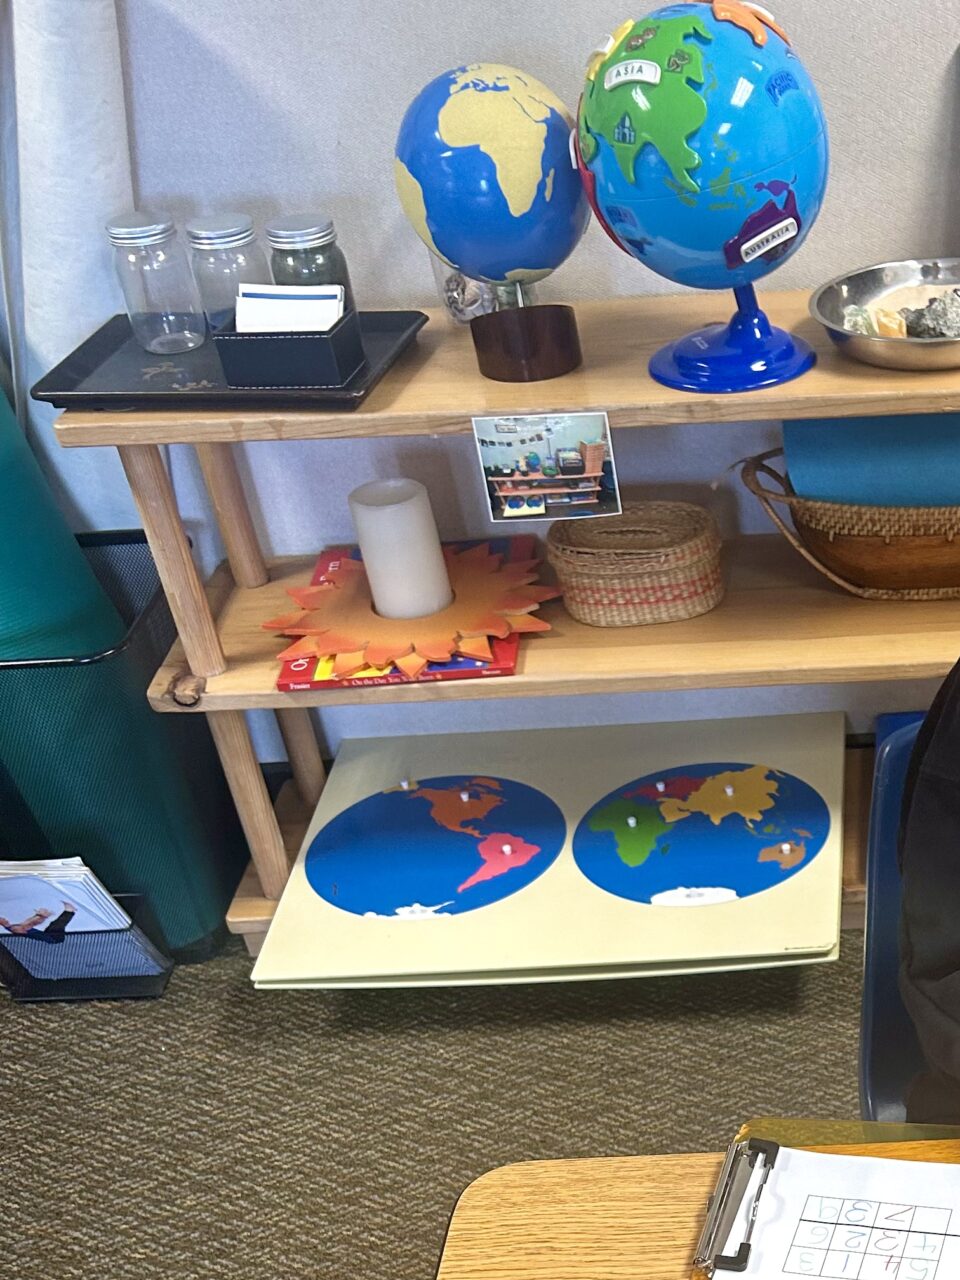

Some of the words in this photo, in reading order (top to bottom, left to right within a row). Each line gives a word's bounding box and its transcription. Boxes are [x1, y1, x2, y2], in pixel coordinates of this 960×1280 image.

[615, 65, 643, 78] ASIA
[744, 226, 790, 257] AUSTRALIA
[845, 1201, 872, 1223] 3
[884, 1206, 912, 1222] 7
[808, 1226, 829, 1244] 6
[845, 1231, 866, 1248] 2
[874, 1231, 901, 1251] 3
[800, 1252, 814, 1271] 3
[841, 1253, 849, 1272] 1
[884, 1255, 901, 1274] 4
[906, 1259, 928, 1280] 5
